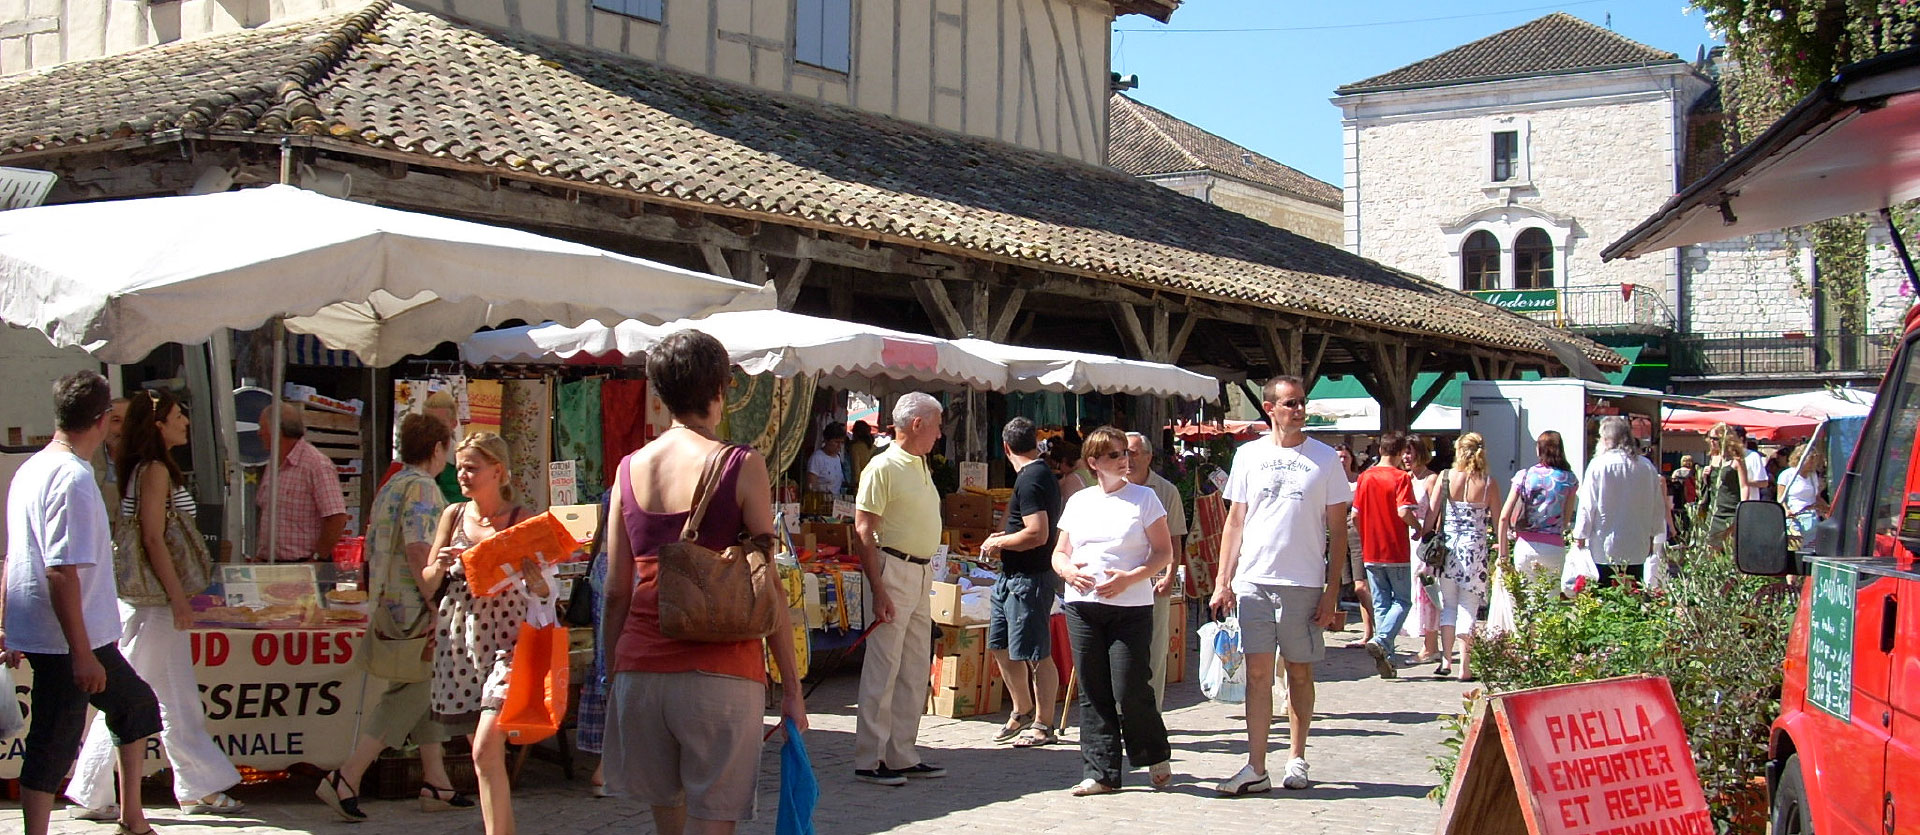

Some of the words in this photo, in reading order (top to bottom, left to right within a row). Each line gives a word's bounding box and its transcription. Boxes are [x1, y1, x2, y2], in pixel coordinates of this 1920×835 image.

[1485, 293, 1555, 308] Moderne
[252, 631, 365, 666] OUES
[1545, 703, 1655, 754] PAELLA
[1530, 764, 1547, 795] A
[1547, 745, 1676, 792] EMPORTER
[1558, 795, 1591, 828] ET
[1604, 779, 1684, 820] REPAS
[1595, 810, 1713, 835] ANDE
